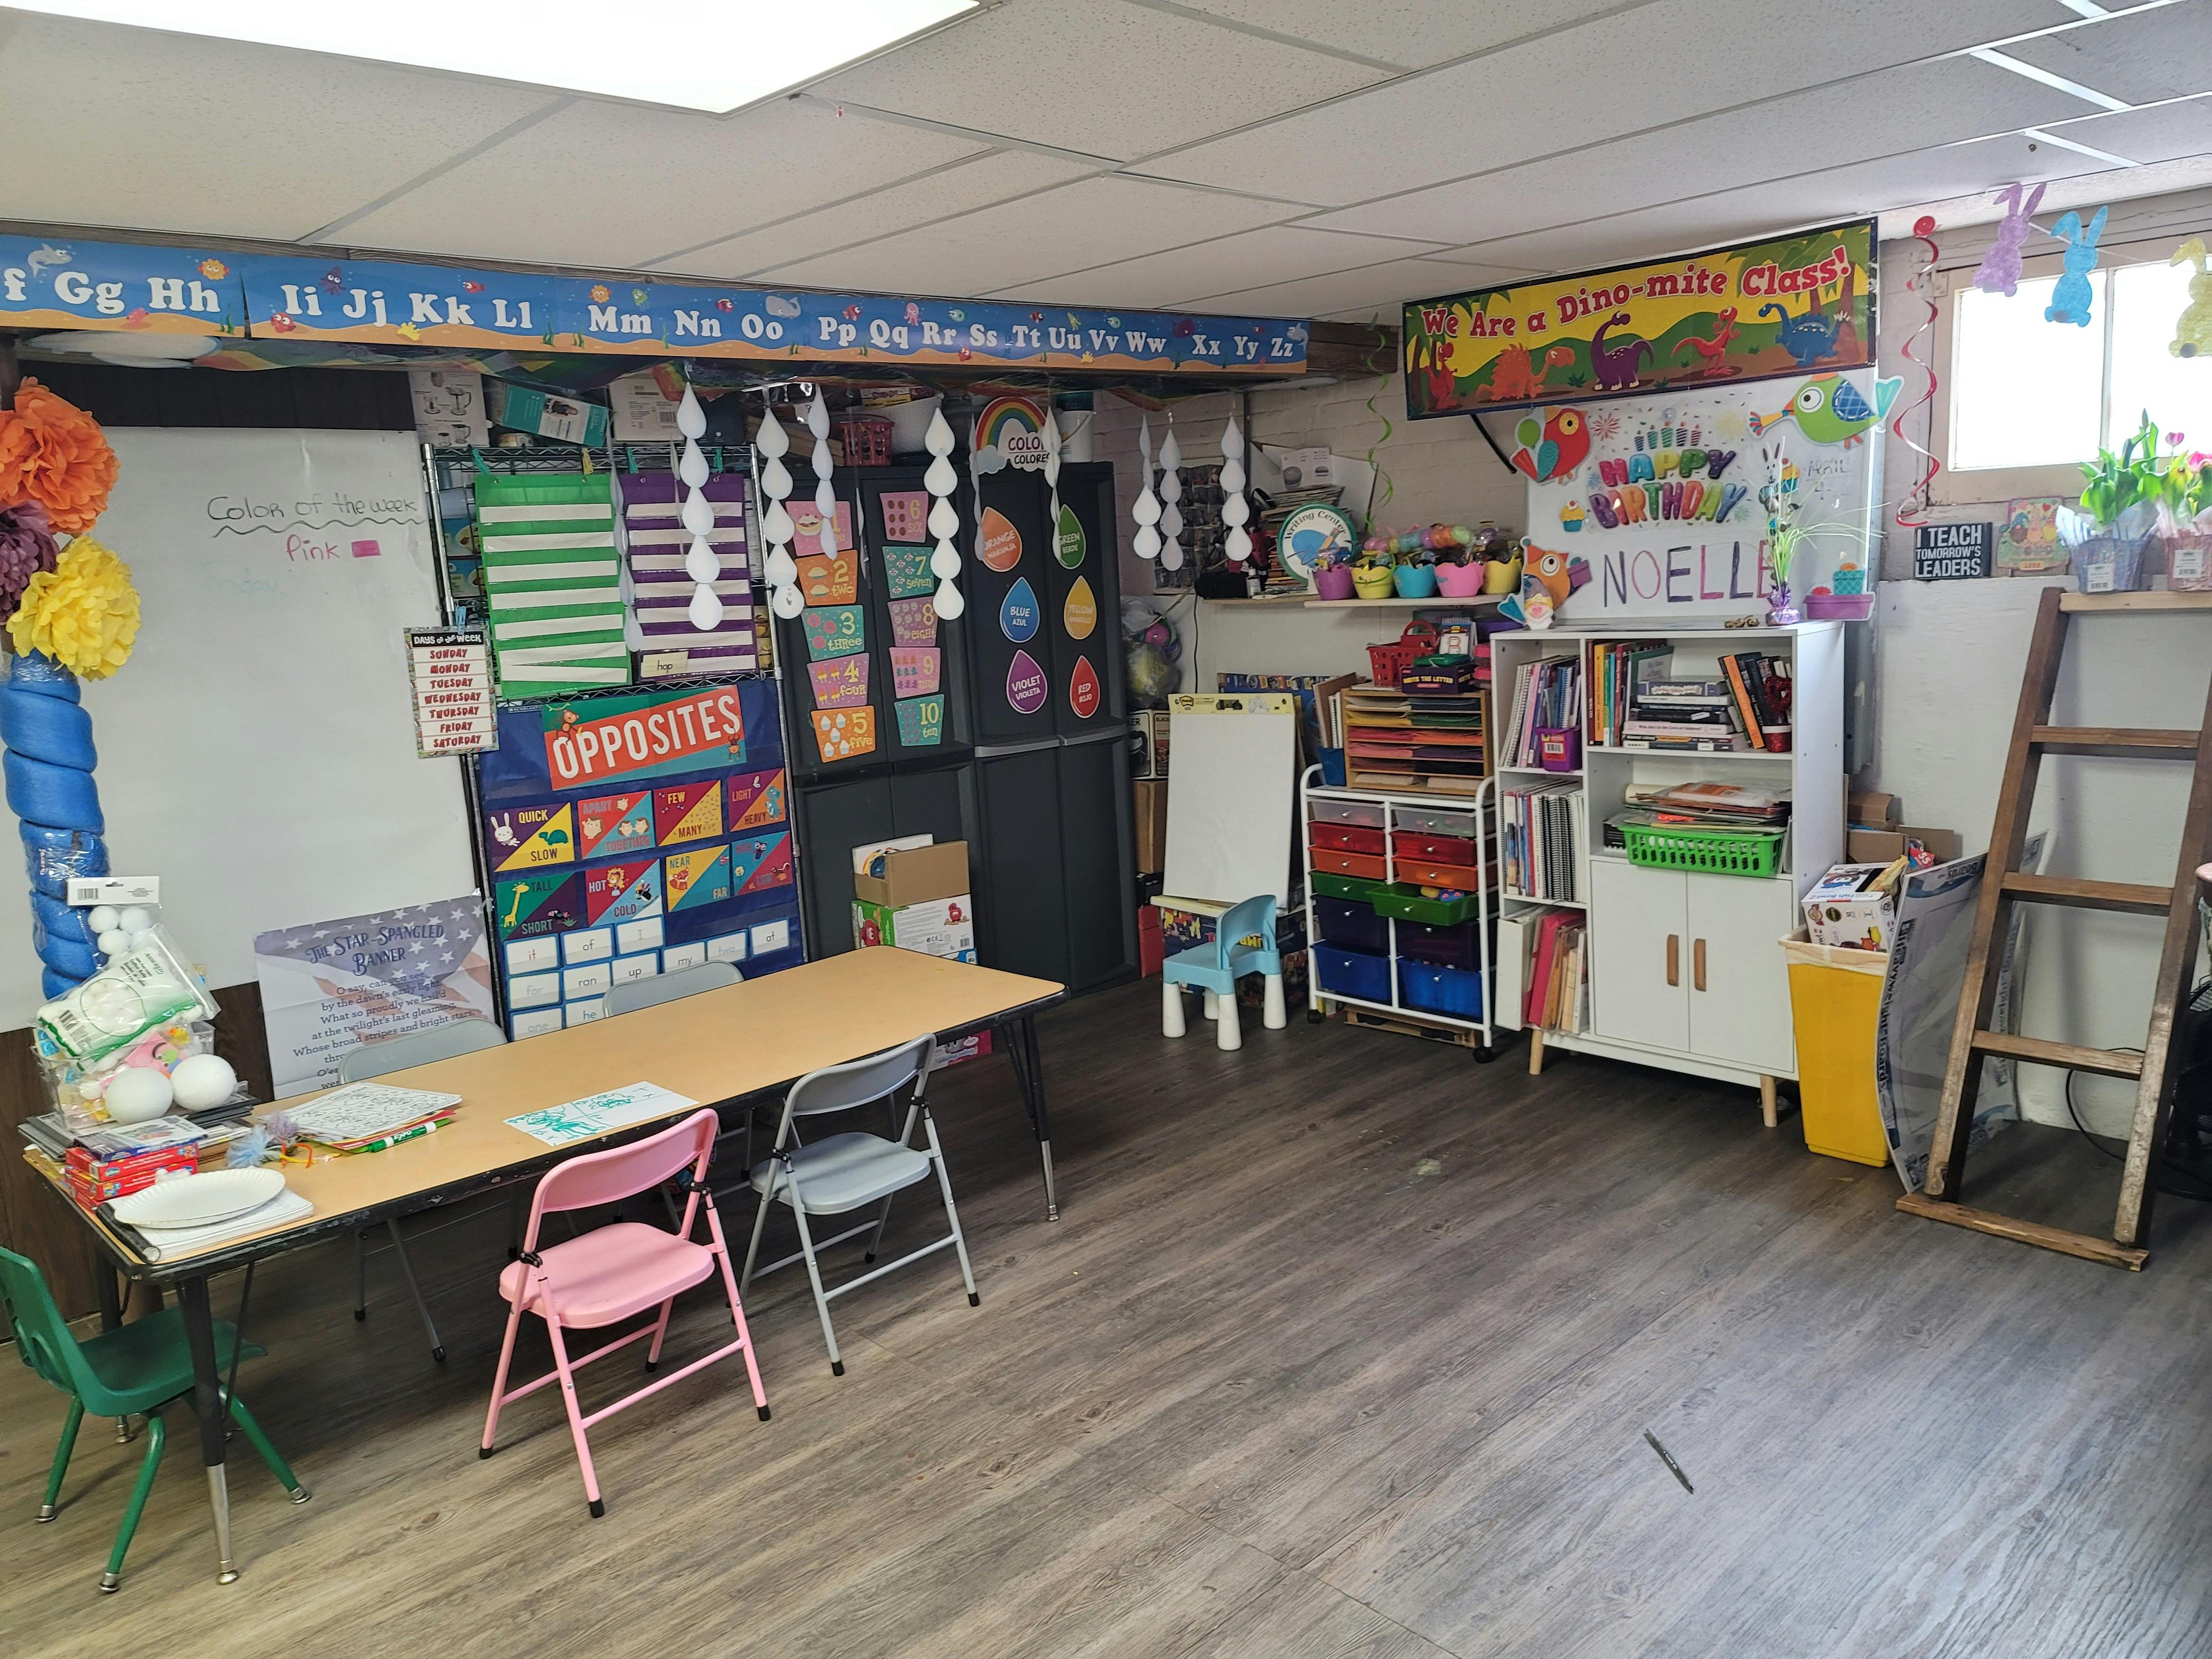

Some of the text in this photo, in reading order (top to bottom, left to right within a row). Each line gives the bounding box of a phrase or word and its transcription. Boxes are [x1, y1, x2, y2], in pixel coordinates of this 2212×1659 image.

[1422, 244, 1852, 339] We Are a Dino-mite Class!
[54, 270, 125, 314] Gg
[149, 276, 221, 313] Hh
[280, 284, 323, 316] Ii
[343, 289, 386, 327] Jj
[408, 292, 474, 326] Kk
[493, 298, 532, 328] Ll
[587, 305, 652, 334] Mm
[673, 310, 722, 338] Nn
[741, 314, 784, 340] Oo
[818, 316, 857, 347] Pp
[869, 319, 909, 349] Qq
[922, 321, 957, 346] Rr
[969, 324, 997, 347] Ss
[1012, 325, 1041, 348] Tt
[1048, 327, 1082, 350] Uu
[1088, 329, 1119, 352] Vv
[1125, 331, 1166, 354] Ww
[1191, 334, 1220, 356] Xx
[1233, 336, 1259, 360] Yy
[1271, 337, 1293, 358] Zz
[1599, 448, 1736, 487] HAPPY
[332, 492, 366, 514] the
[910, 499, 921, 520] 6
[1588, 481, 1748, 529] BIRTHDAY
[1285, 510, 1345, 539] Writing Center
[1916, 524, 1981, 546] I TEACH
[286, 534, 340, 561] Pink
[1915, 544, 1981, 557] TOMORROW'S
[833, 560, 849, 583] 2
[915, 556, 927, 576] 7
[1915, 559, 1981, 577] LEADERS
[922, 603, 933, 626] 8
[1010, 606, 1031, 617] BLUE
[840, 612, 855, 635] 3
[1012, 618, 1027, 627] AZUL
[414, 636, 436, 645] DAYS
[430, 648, 468, 659] SUNDAY
[430, 664, 471, 674] MONDAY
[657, 659, 673, 672] hop
[844, 659, 859, 682] 4
[923, 655, 933, 675] 9
[430, 678, 473, 688] TUESDAY
[1011, 674, 1041, 692] VIOLET
[1078, 683, 1092, 695] RED
[425, 692, 482, 705] WEDNESDAY
[1015, 687, 1041, 700] VIOLETA
[430, 706, 479, 718] THURSDAY
[920, 702, 939, 725] 10
[440, 722, 473, 733] FRIDAY
[852, 712, 867, 734] 5
[434, 734, 482, 748] SATURDAY
[552, 695, 740, 779] OPPOSITES
[667, 791, 686, 805] FEW
[732, 789, 752, 802] LIGHT
[518, 809, 548, 823] QUICK
[744, 812, 767, 825] HEAVY
[679, 824, 703, 838] MANY
[530, 848, 558, 862] SLOW
[670, 856, 690, 869] NEAR
[531, 880, 552, 893] TALL
[588, 880, 607, 893] HOT
[713, 887, 727, 899] FAR
[614, 904, 636, 917] COLD
[521, 919, 552, 935] SHORT
[766, 931, 776, 943] at
[582, 940, 594, 952] of
[353, 947, 405, 976] BANNER
[528, 948, 536, 961] it
[677, 955, 692, 967] my
[628, 967, 642, 979] up
[337, 987, 346, 995] O
[369, 980, 387, 989] can
[578, 976, 597, 988] ran
[321, 1003, 334, 1012] by
[337, 998, 353, 1009] the
[392, 985, 415, 999] early
[321, 1013, 349, 1024] What
[366, 999, 404, 1015] proudly
[406, 998, 419, 1006] we
[583, 1009, 597, 1020] he
[312, 1031, 323, 1040] at
[325, 1026, 341, 1037] the
[393, 1013, 410, 1022] last
[294, 1043, 330, 1057] Whose
[332, 1035, 362, 1048] broad
[364, 1029, 398, 1042] stripes
[400, 1022, 418, 1033] and
[420, 1014, 448, 1030] bright
[394, 1129, 413, 1141] EXPO
